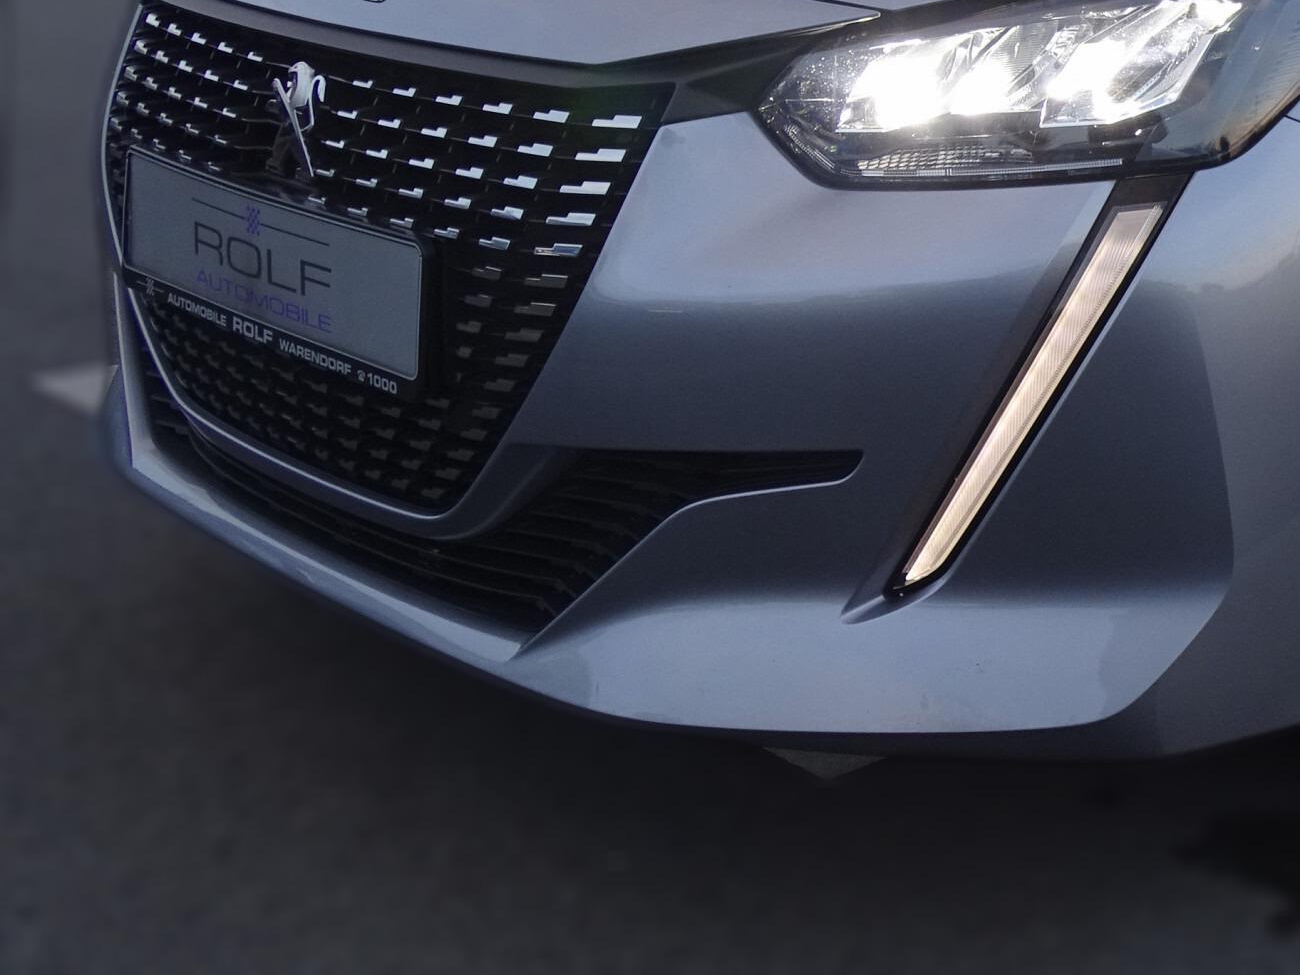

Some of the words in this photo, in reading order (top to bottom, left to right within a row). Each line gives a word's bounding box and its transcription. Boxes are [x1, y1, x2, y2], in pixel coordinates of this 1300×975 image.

[194, 220, 333, 296] ROLF
[167, 292, 228, 328] AUTOMOBILE
[232, 315, 274, 344] ROLF
[278, 337, 353, 376] WARENDORF
[196, 269, 333, 334] AUTOMOBILE
